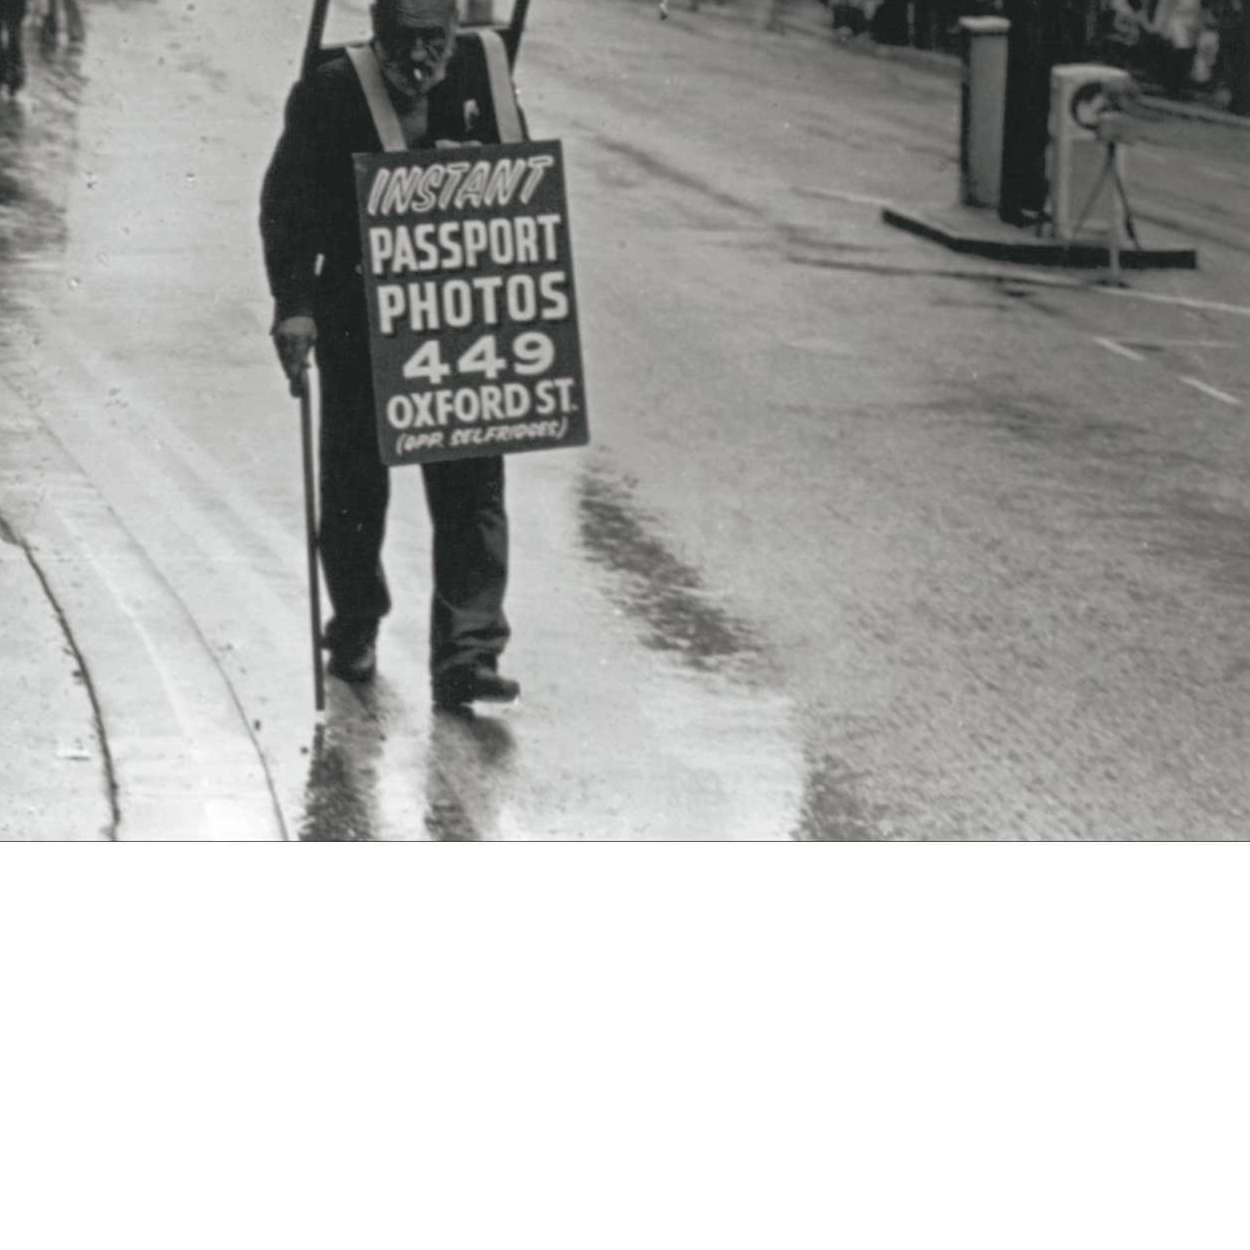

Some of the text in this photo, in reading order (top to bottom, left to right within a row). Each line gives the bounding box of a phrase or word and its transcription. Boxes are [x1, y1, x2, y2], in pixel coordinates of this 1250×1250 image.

[367, 155, 555, 215] INSTANT
[369, 214, 562, 275] PASSPORT
[377, 270, 570, 334] PHOTOS
[402, 331, 556, 384] 449
[387, 377, 580, 430] OXFORD ST.
